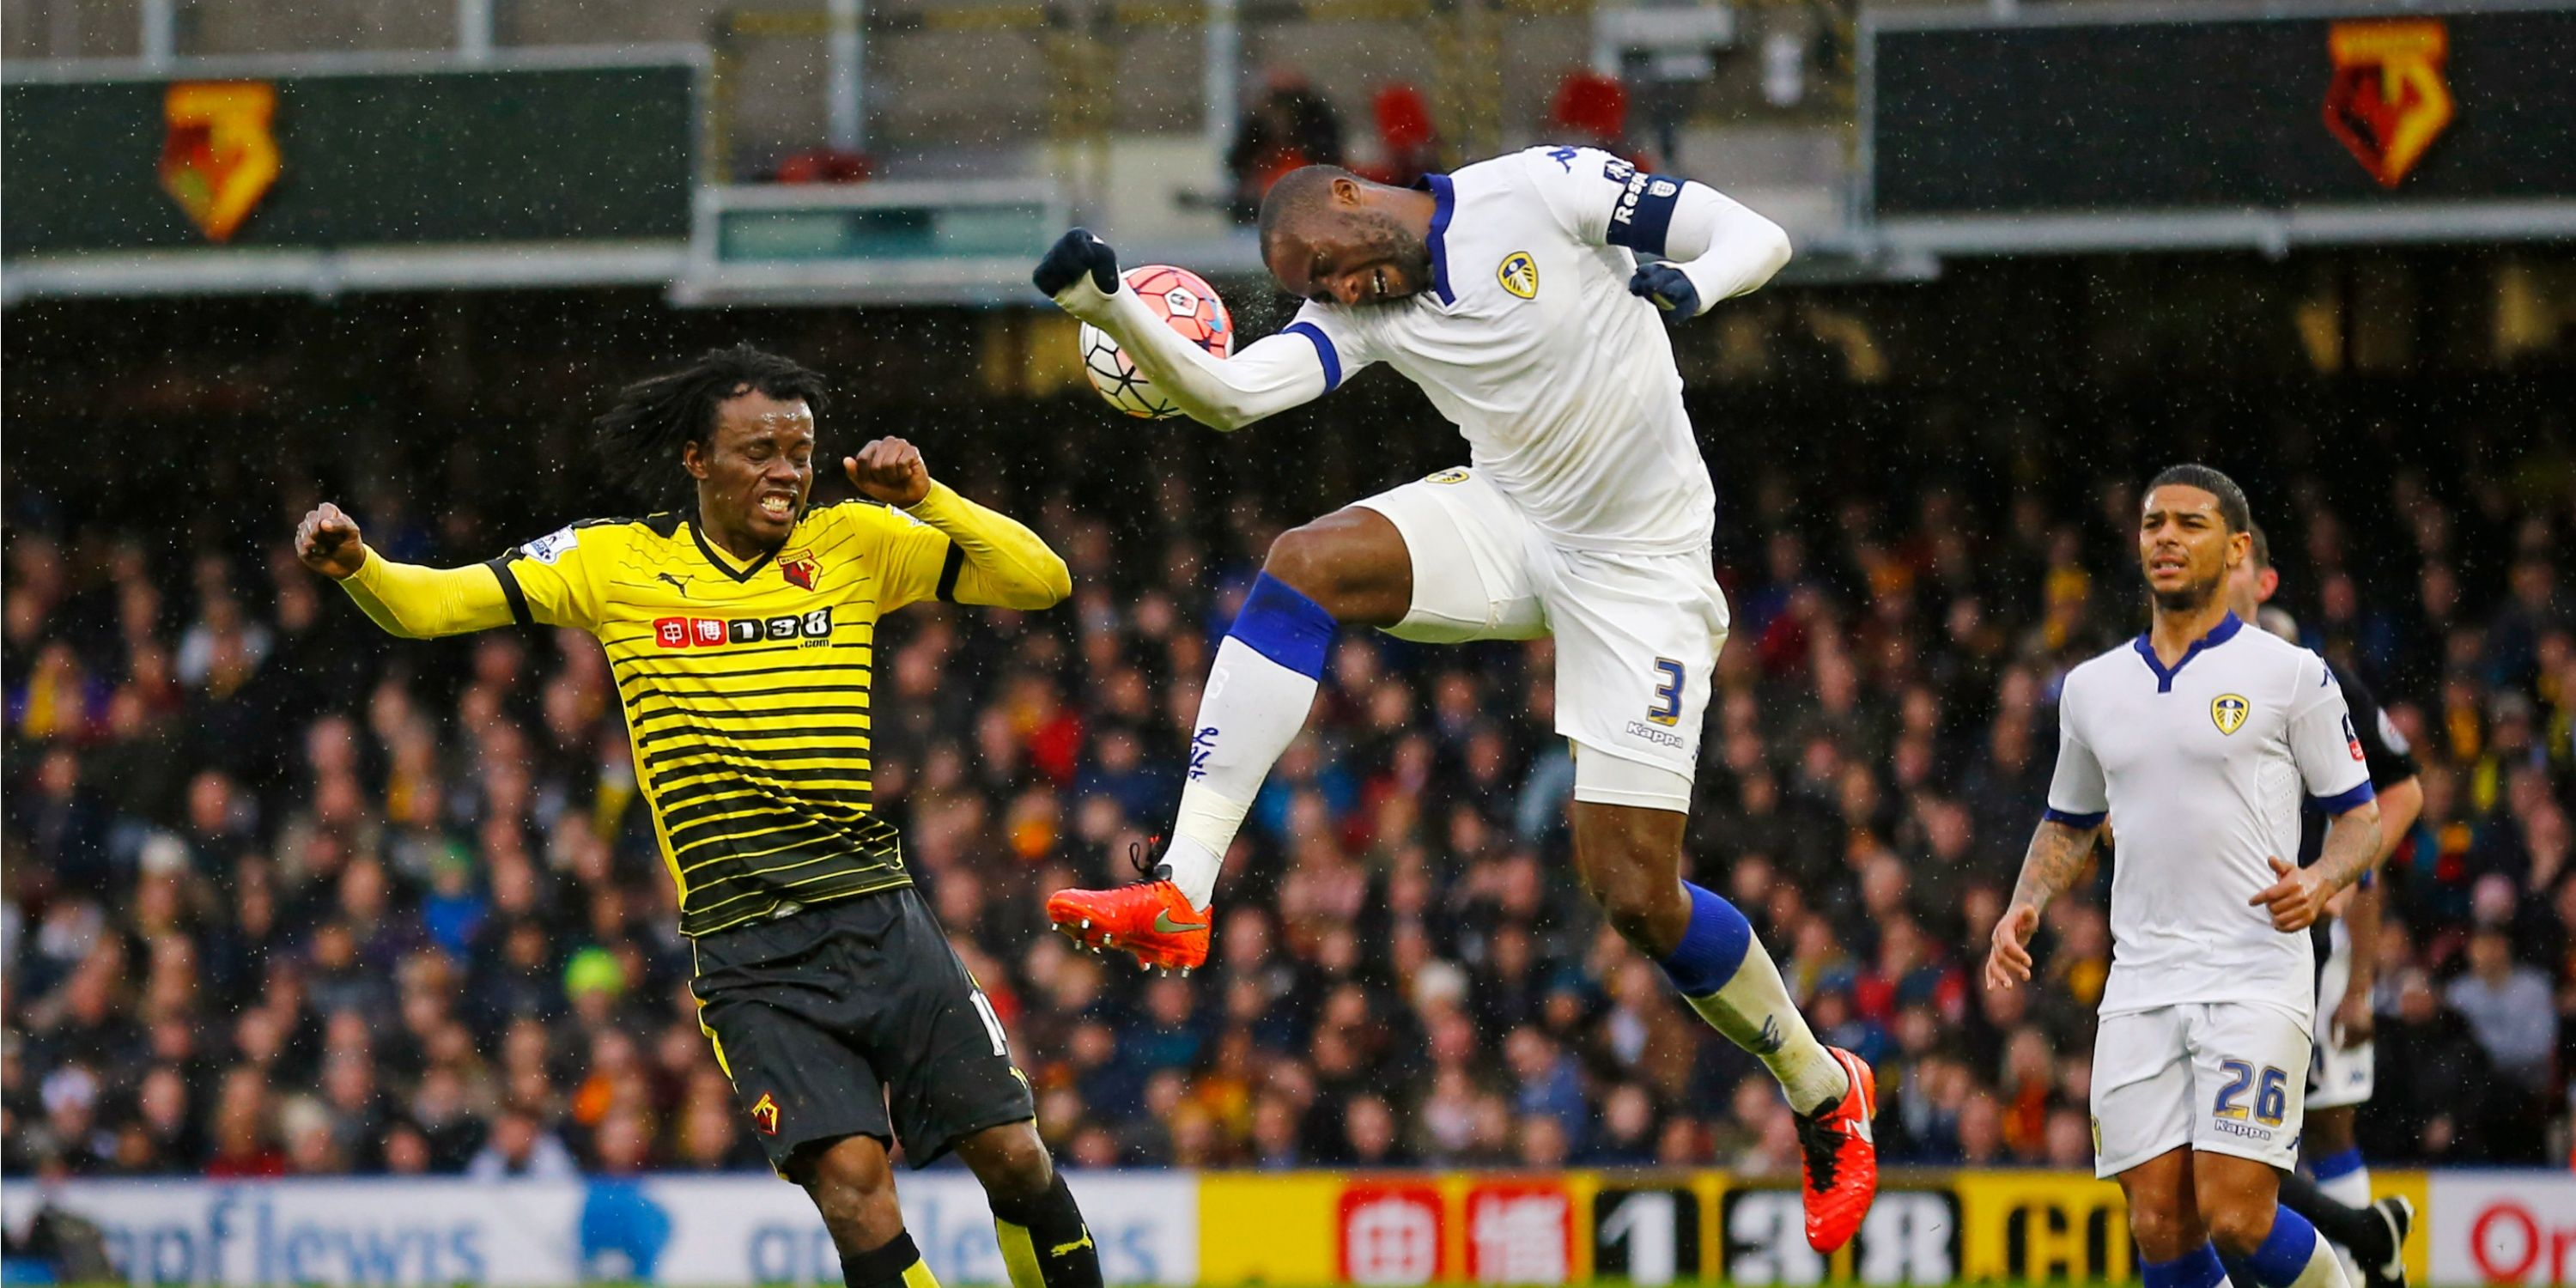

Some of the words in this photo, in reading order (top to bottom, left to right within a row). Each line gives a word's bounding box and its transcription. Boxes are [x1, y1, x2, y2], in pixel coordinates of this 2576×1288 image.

[799, 639, 830, 648] .com
[1646, 656, 1686, 727] 3
[1626, 720, 1684, 750] Kappa
[2213, 1059, 2287, 1128] 26
[2215, 1118, 2271, 1141] Kappa
